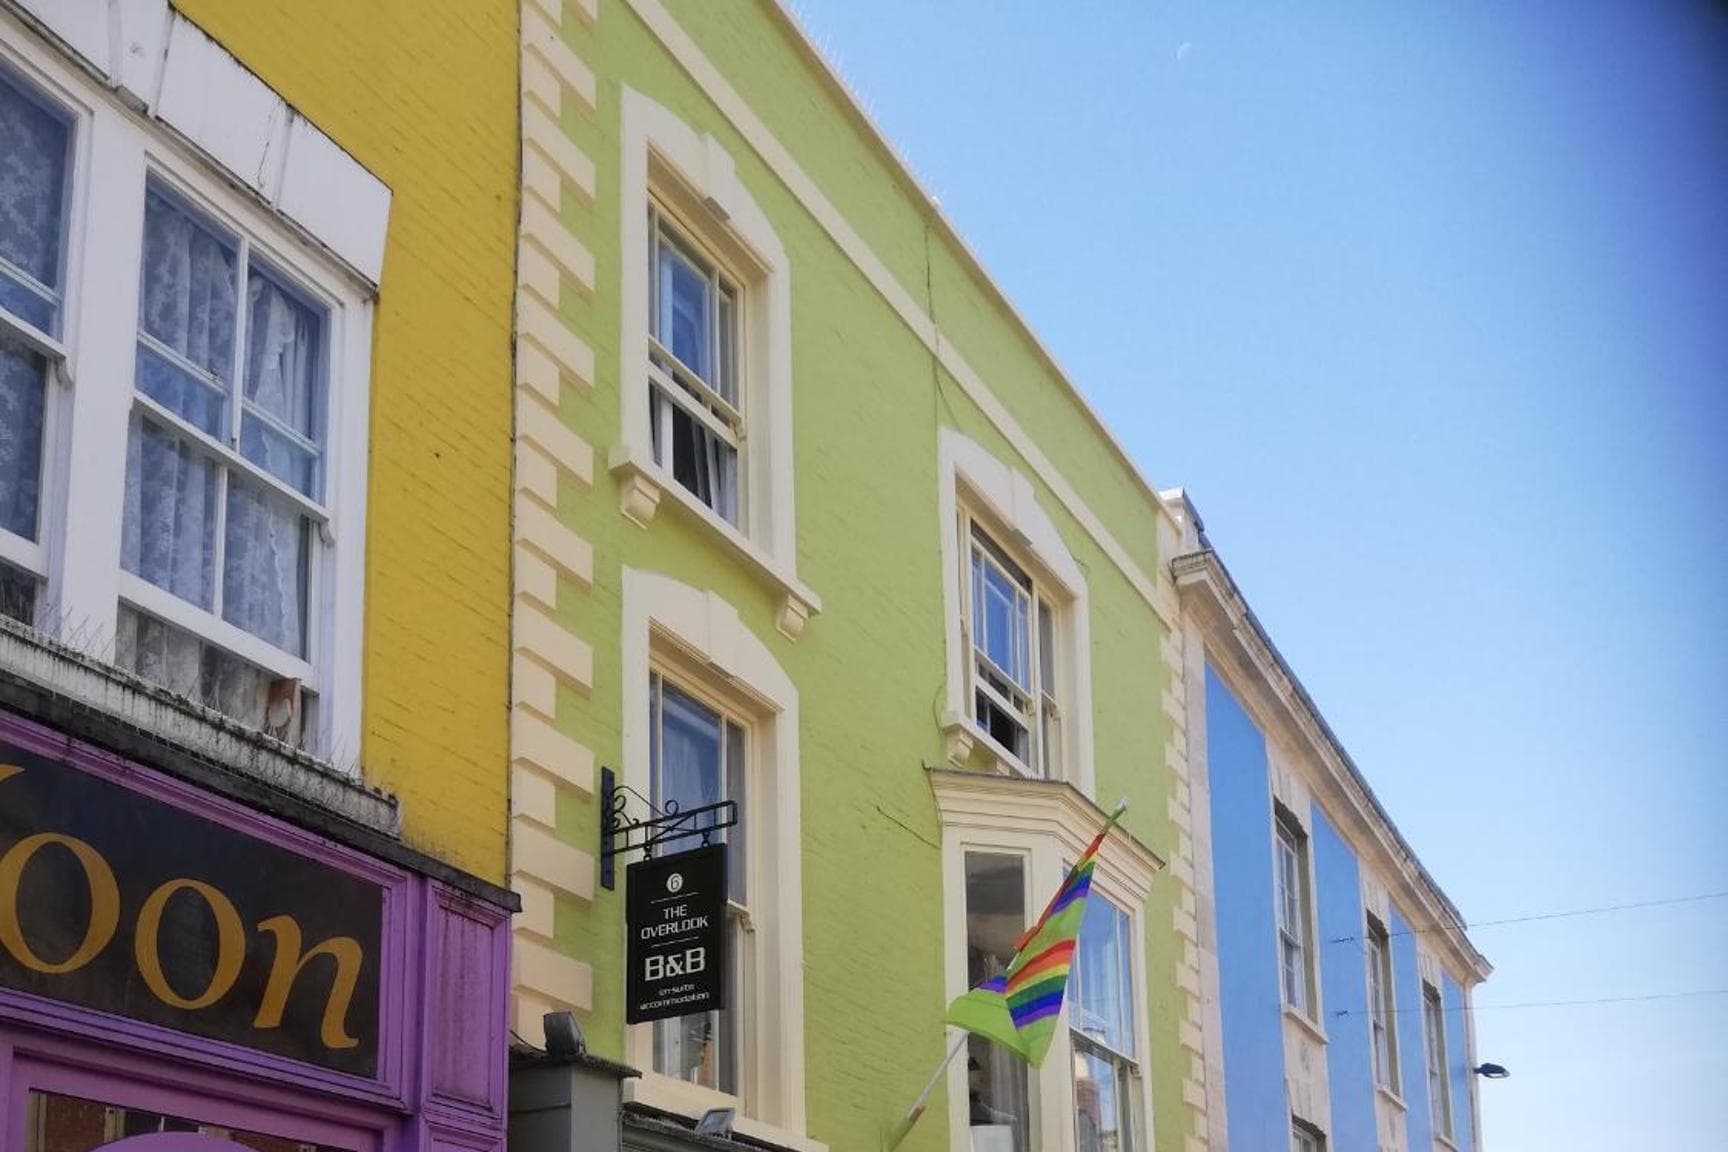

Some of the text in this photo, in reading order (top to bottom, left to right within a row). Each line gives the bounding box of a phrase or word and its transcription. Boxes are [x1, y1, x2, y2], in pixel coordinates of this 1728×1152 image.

[668, 874, 682, 892] 6
[0, 764, 363, 1049] oon
[663, 904, 688, 920] THE
[641, 916, 709, 939] OVERLOOK
[644, 947, 706, 981] B&B
